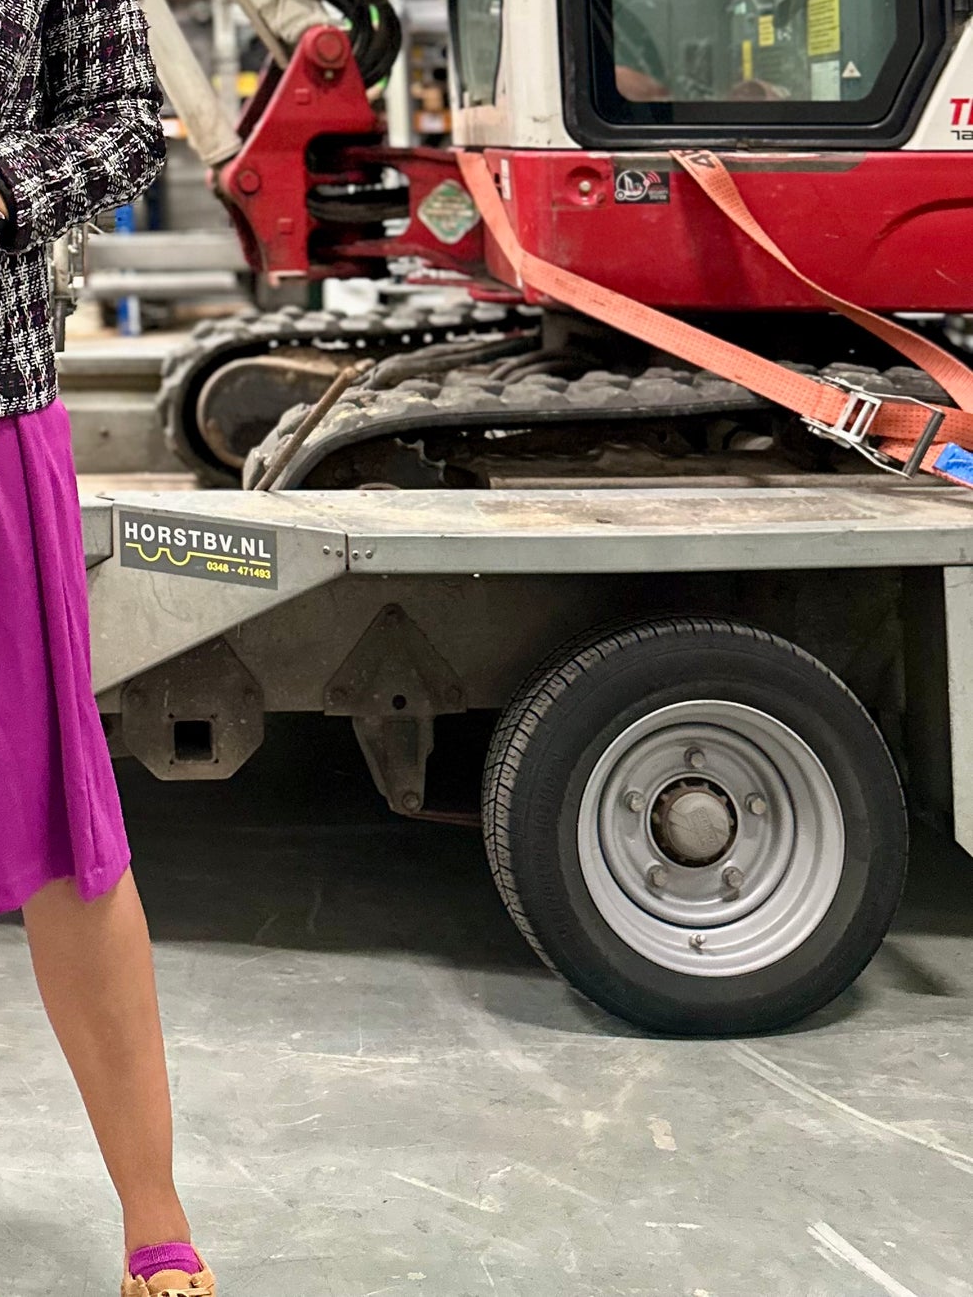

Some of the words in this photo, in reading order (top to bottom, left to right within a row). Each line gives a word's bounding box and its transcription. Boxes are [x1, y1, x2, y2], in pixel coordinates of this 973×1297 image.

[950, 98, 973, 126] T
[124, 521, 271, 558] HORSTBV.NL
[207, 561, 229, 573] 0348
[237, 566, 271, 579] 471493
